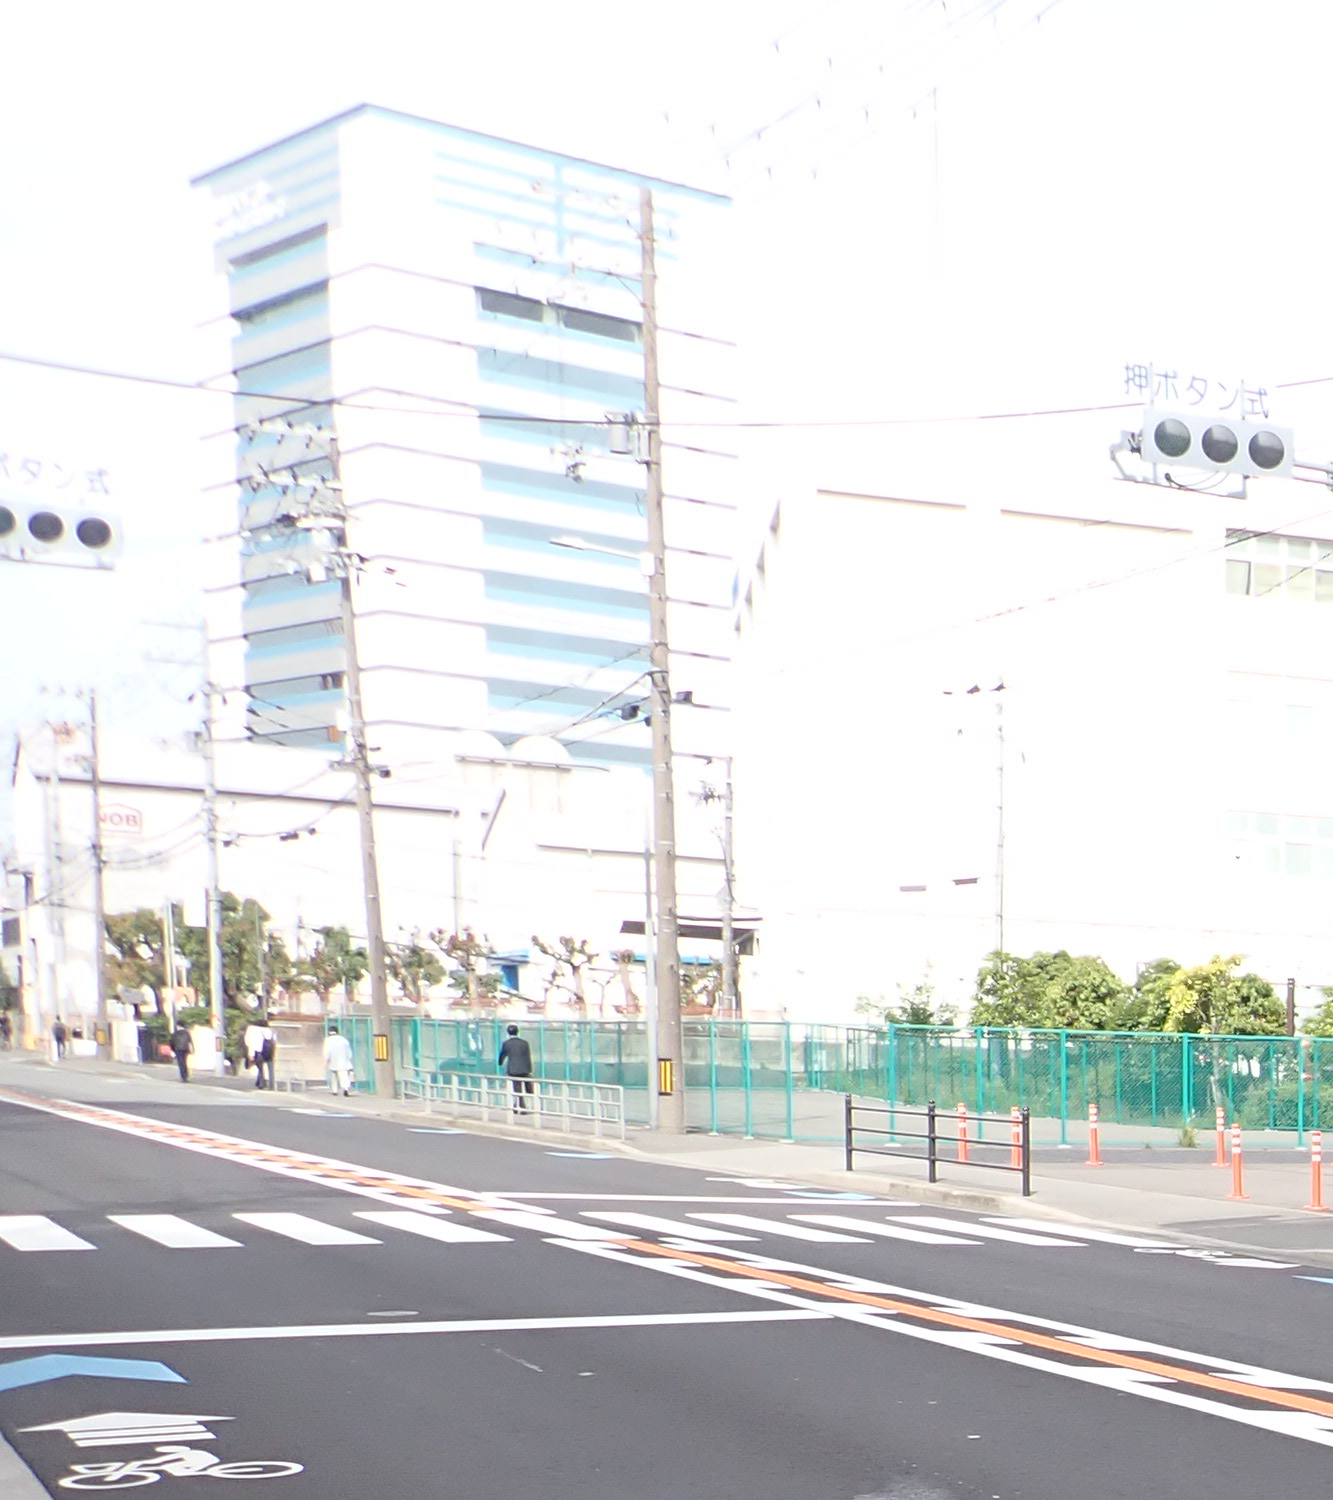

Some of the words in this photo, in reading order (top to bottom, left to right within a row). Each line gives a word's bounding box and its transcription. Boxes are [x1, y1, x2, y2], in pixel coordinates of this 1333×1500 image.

[1124, 362, 1269, 419] 押ボタン式
